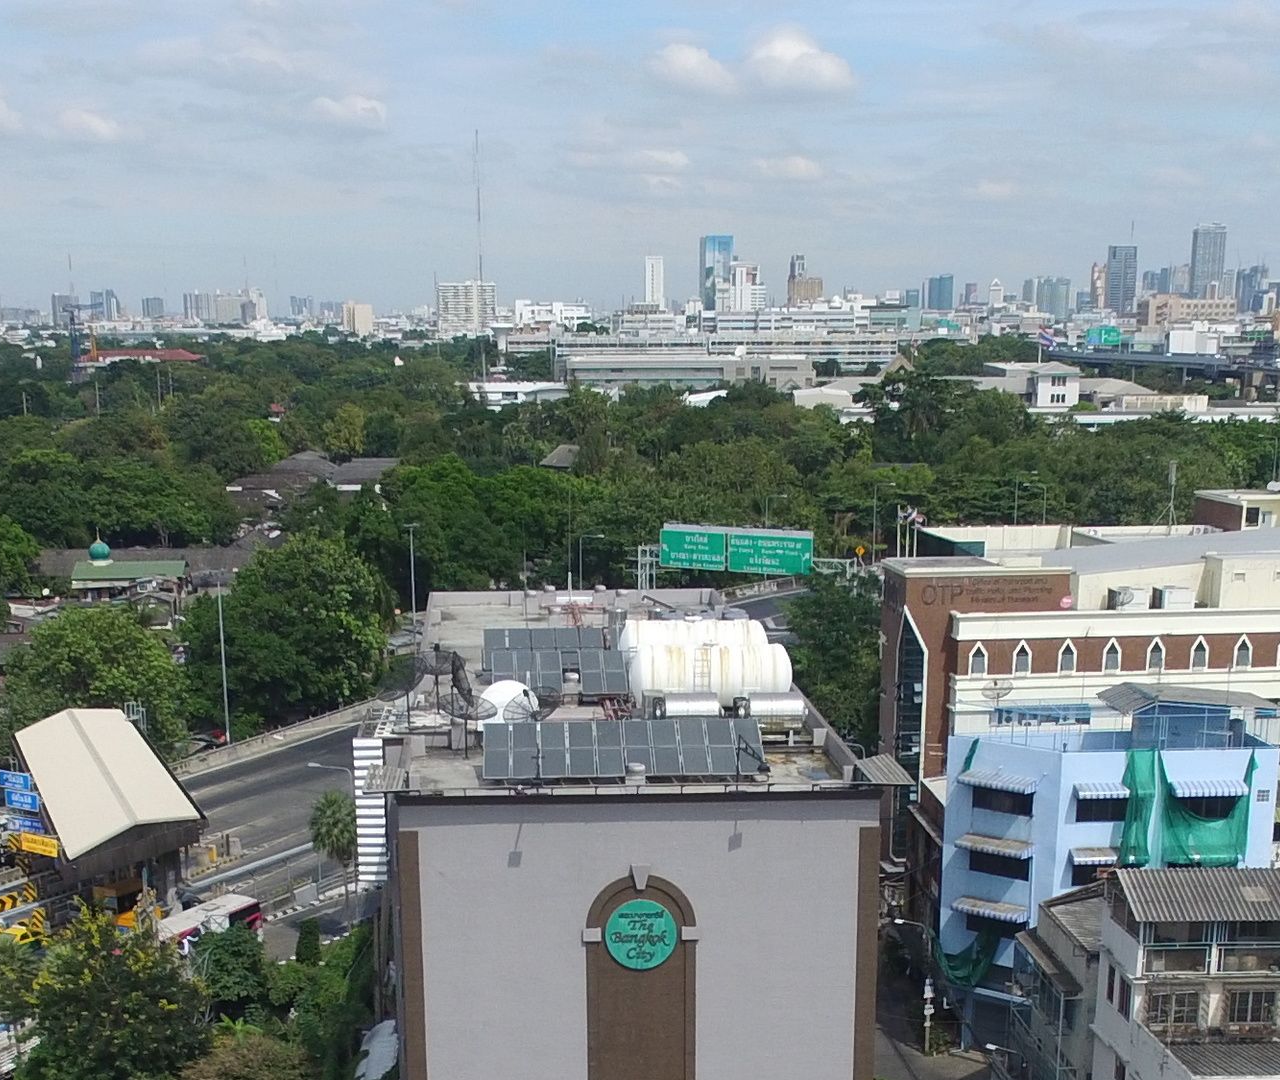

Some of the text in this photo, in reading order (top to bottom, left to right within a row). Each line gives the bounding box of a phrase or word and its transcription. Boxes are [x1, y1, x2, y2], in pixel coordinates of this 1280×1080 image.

[921, 582, 964, 605] OTP
[627, 919, 655, 932] The
[610, 930, 670, 948] Bangkok
[626, 947, 656, 963] City
